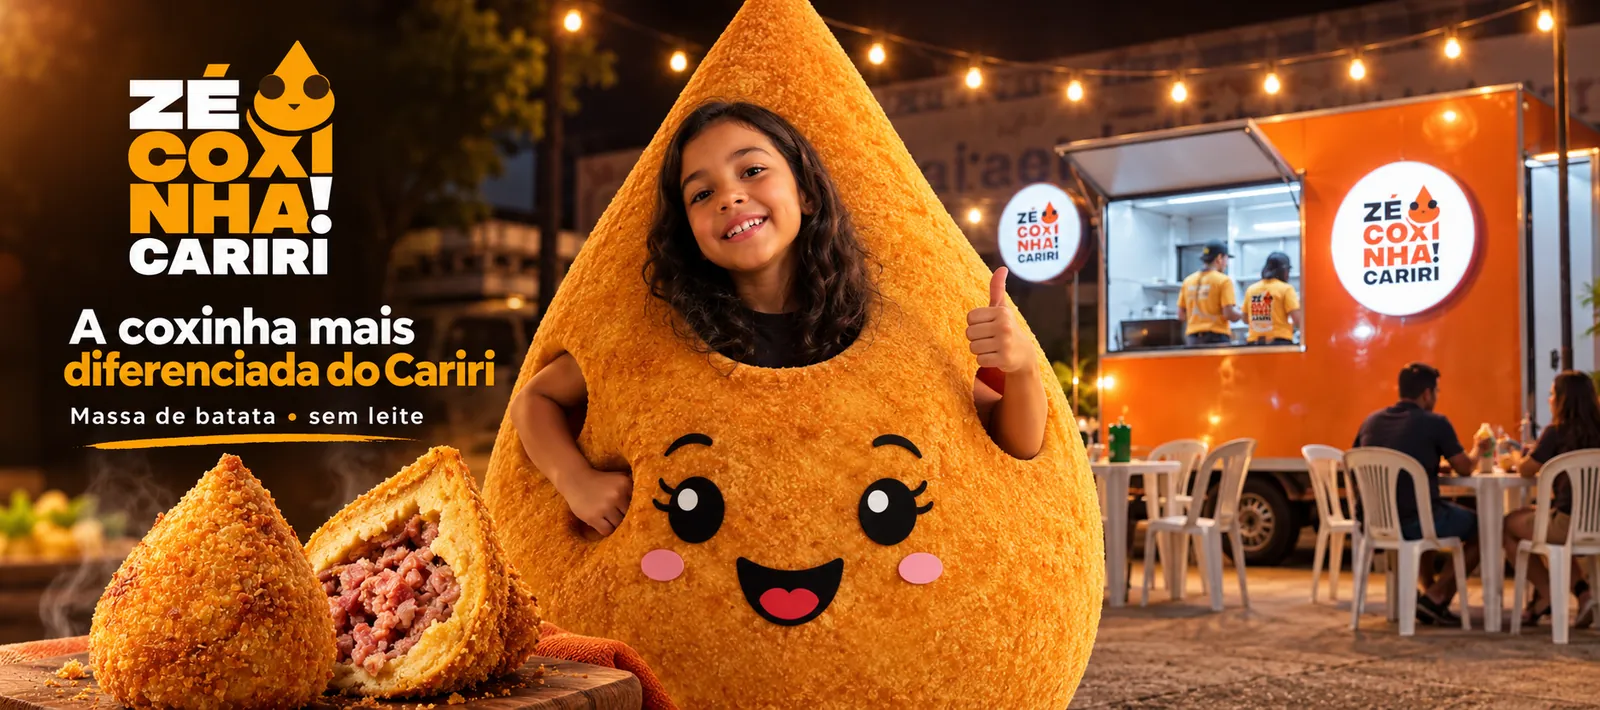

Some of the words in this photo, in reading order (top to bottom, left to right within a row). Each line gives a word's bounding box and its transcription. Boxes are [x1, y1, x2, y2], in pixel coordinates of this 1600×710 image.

[1017, 207, 1038, 224] ZÉ
[1363, 194, 1402, 223] ZÉ
[1017, 224, 1059, 238] COXI
[1363, 217, 1440, 246] COXI
[1018, 236, 1059, 252] NHA!
[1017, 251, 1059, 264] CARIRI
[1363, 242, 1440, 268] NHA!
[1363, 265, 1440, 286] CARIRI
